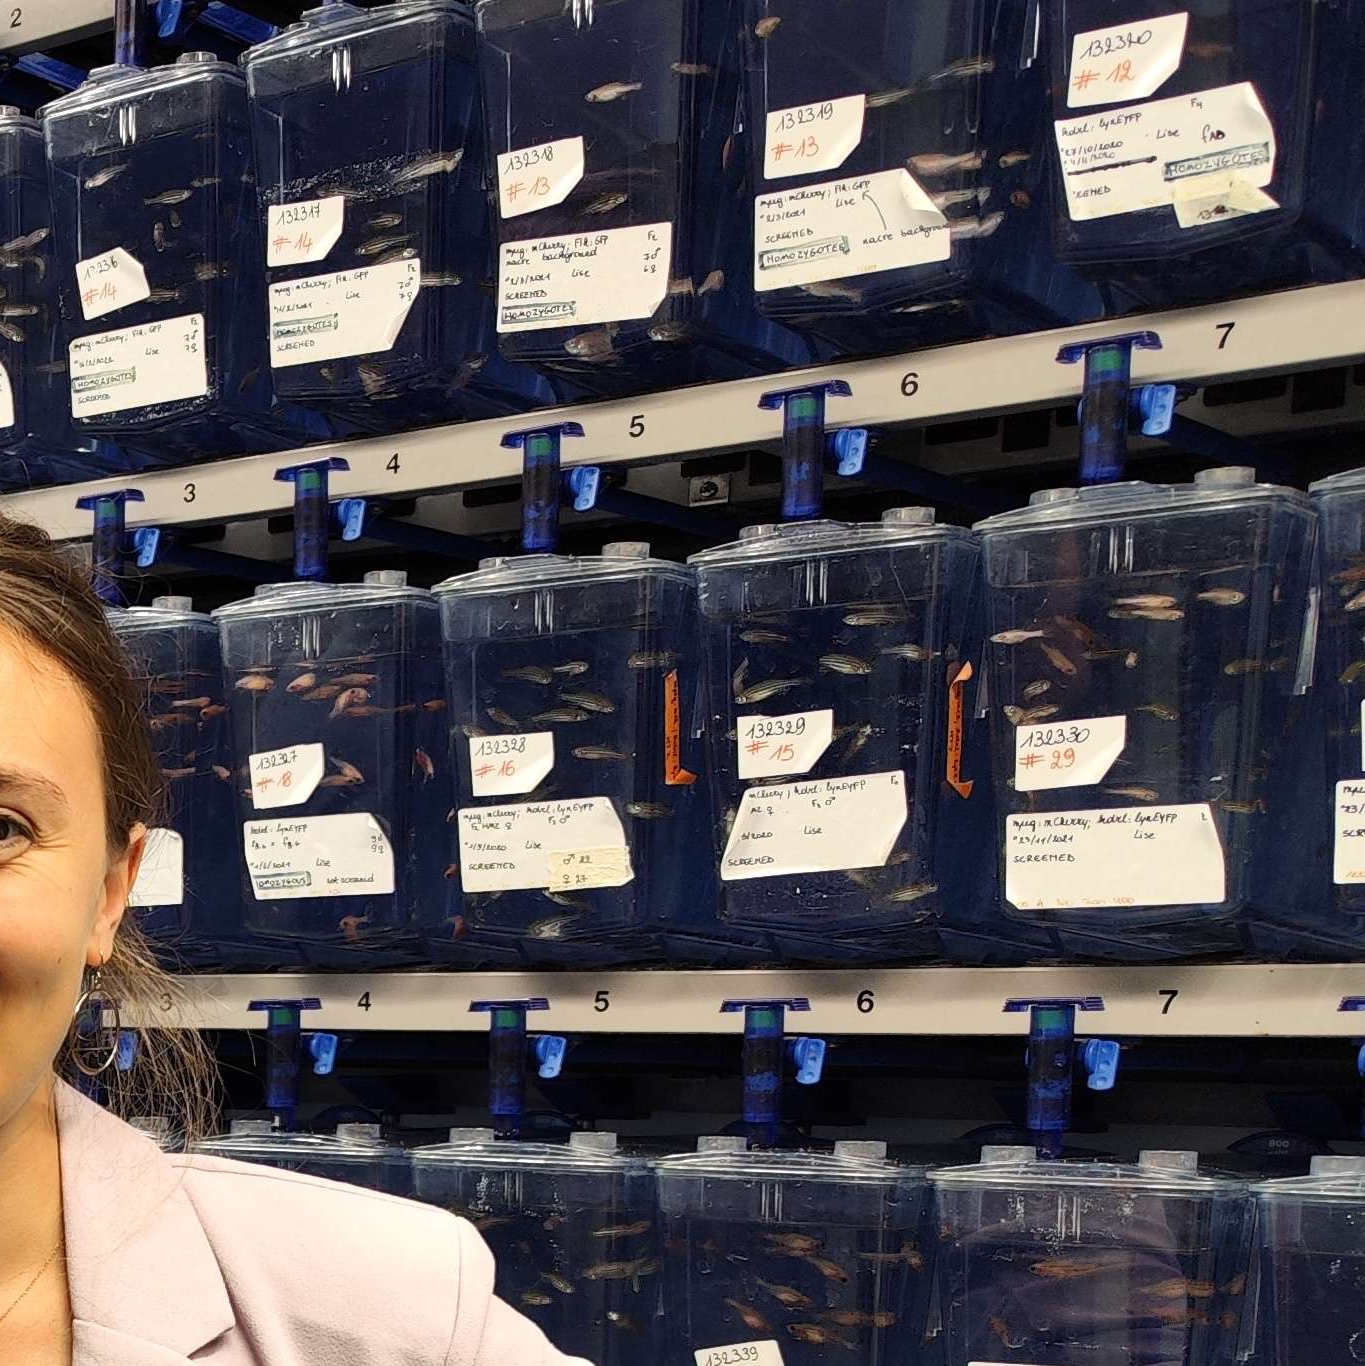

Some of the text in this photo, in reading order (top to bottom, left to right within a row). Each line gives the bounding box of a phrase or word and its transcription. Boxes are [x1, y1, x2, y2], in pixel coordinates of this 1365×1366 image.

[10, 9, 22, 28] 2
[1080, 30, 1152, 60] 132320
[775, 102, 835, 133] 132319
[1156, 128, 1180, 139] Lise
[504, 145, 554, 176] 132318
[835, 198, 856, 208] Lise
[277, 203, 321, 226] 132317
[1216, 323, 1236, 349] 7
[901, 372, 919, 397] 6
[629, 416, 645, 437] 5
[386, 454, 400, 474] 4
[183, 483, 196, 503] 3
[745, 716, 806, 739] 132329
[1020, 727, 1090, 749] 132330
[474, 737, 527, 757] 132328
[256, 750, 298, 771] 132327
[803, 825, 823, 835] Lise
[1133, 830, 1157, 841] Lise
[525, 841, 542, 850] Lise
[357, 993, 372, 1012] 4
[594, 991, 610, 1012] 5
[856, 990, 874, 1014] 6
[1158, 990, 1179, 1014] 7
